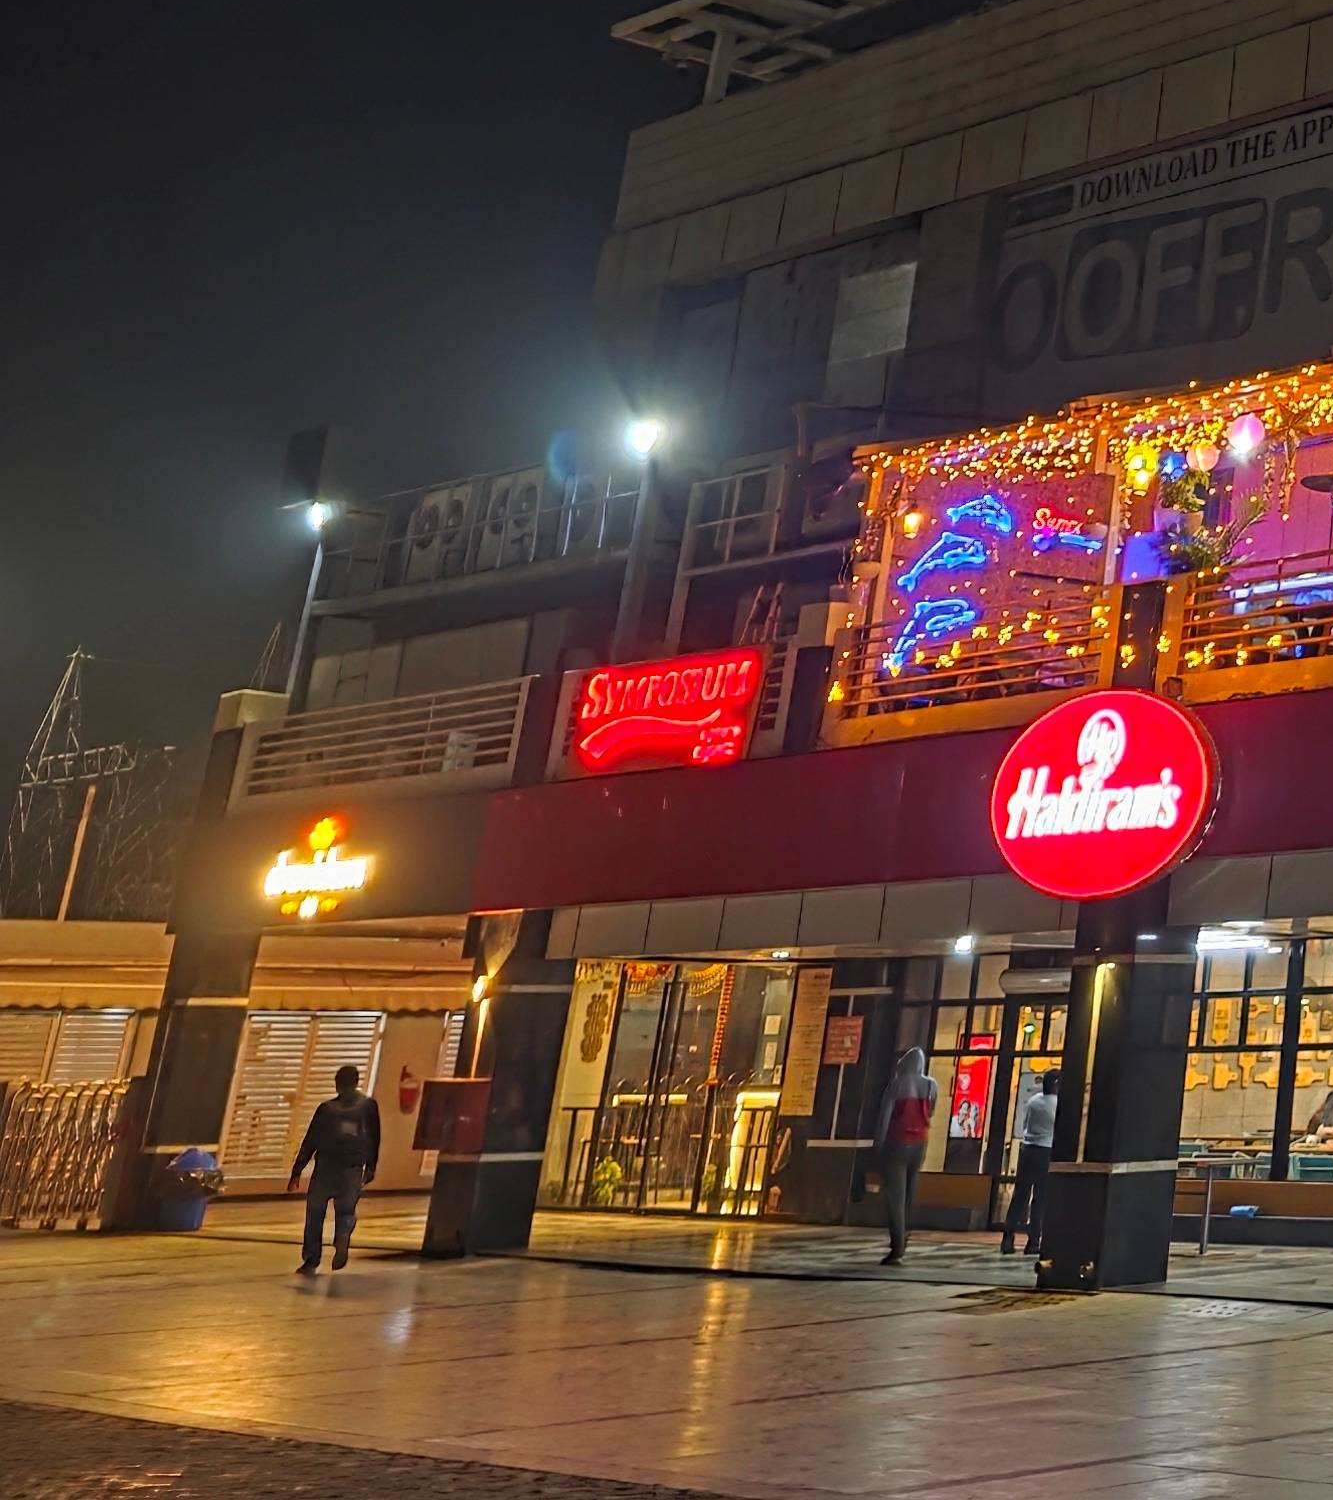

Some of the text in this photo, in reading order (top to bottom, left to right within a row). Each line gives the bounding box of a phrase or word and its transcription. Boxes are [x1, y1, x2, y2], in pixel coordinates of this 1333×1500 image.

[1080, 146, 1218, 209] DOWNLOAD
[1226, 129, 1276, 168] THE
[581, 660, 753, 719] SYMPOSIUM
[1005, 765, 1183, 841] Haldiram's
